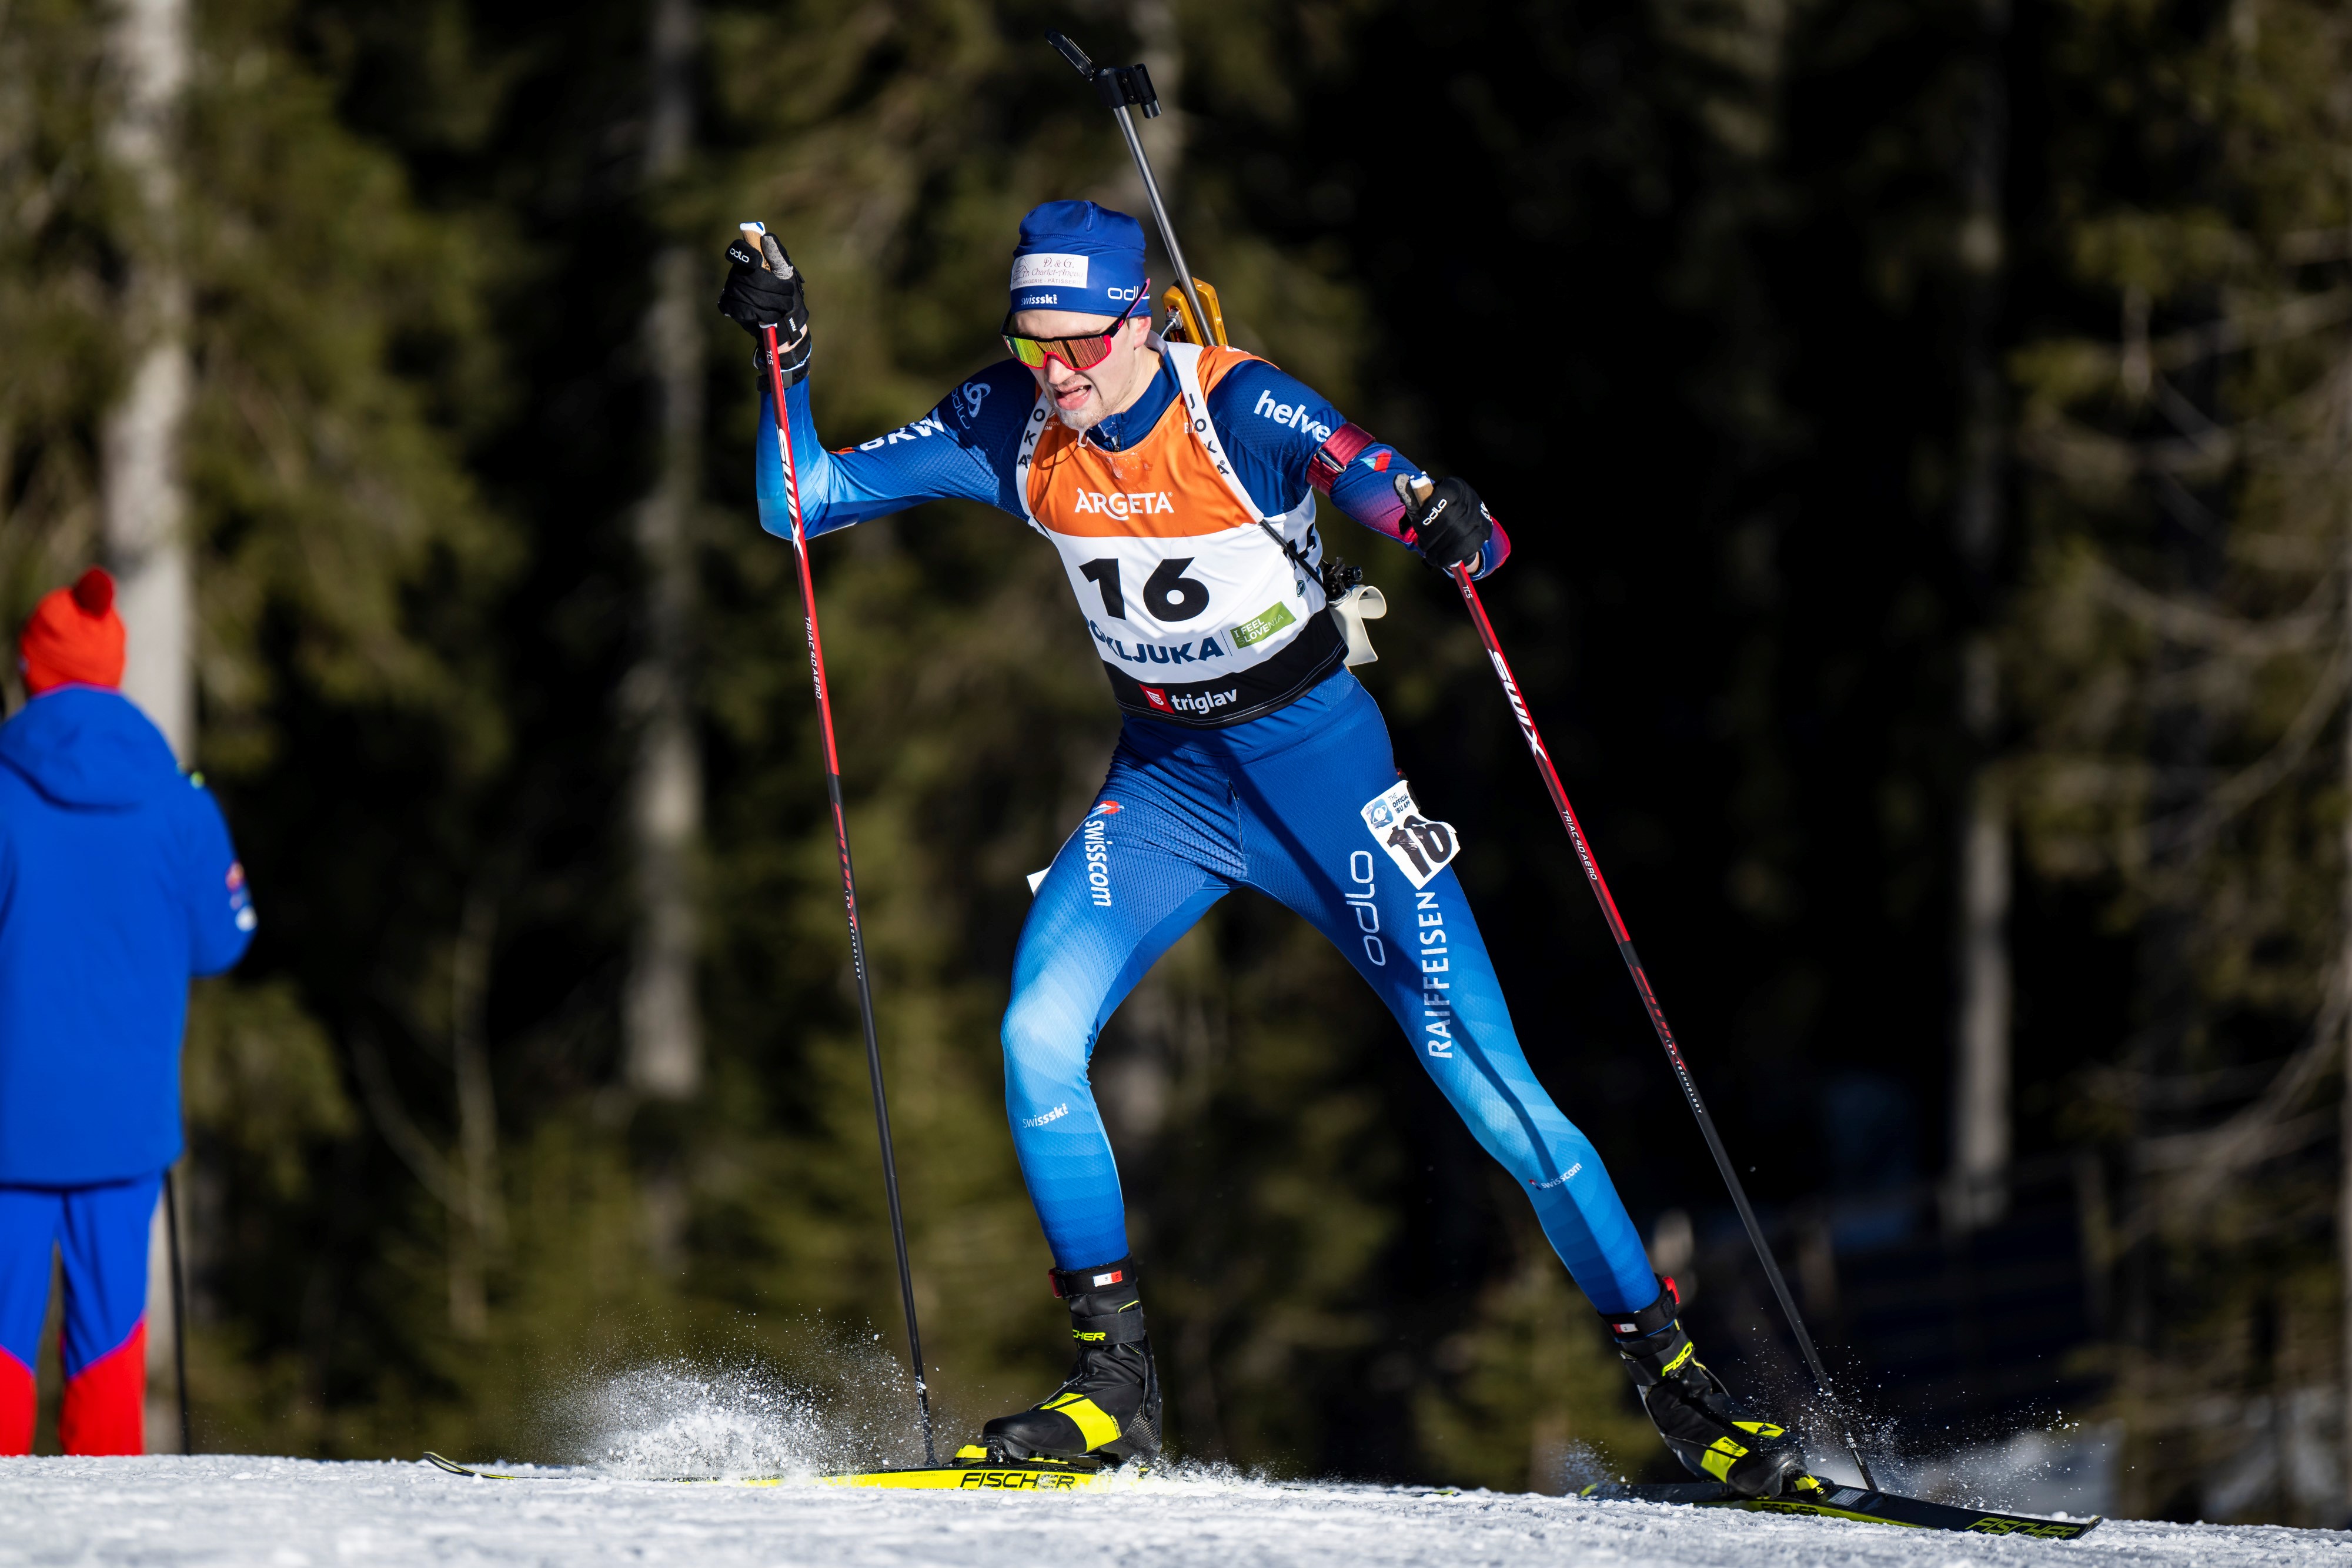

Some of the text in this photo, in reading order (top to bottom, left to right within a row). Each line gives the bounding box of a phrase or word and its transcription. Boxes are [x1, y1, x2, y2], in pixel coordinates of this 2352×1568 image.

[730, 248, 749, 263] odlo
[1054, 259, 1061, 268] &
[1021, 294, 1058, 305] swissski
[789, 317, 797, 332] WARM
[1254, 389, 1332, 443] helve
[1422, 499, 1447, 526] odlo
[1078, 556, 1210, 622] 16
[1462, 585, 1473, 599] TCS
[1238, 614, 1284, 646] SLOVENIA
[1241, 617, 1264, 635] FEEL
[805, 617, 815, 649] TRIAC
[812, 667, 821, 699] AERO
[1171, 688, 1237, 714] triglav
[1388, 793, 1398, 802] THE
[1392, 793, 1409, 808] OFFICIAL
[1562, 810, 1598, 881] TRIAC 4.0 AERO
[1084, 820, 1112, 907] swisscom
[1345, 850, 1386, 966] odlo
[1415, 892, 1452, 1058] RAIFFEISEN
[1023, 1103, 1068, 1128] swissski
[1541, 1162, 1582, 1188] swisscom
[1662, 1341, 1693, 1376] FISC
[960, 1472, 1075, 1490] FISCHER
[1965, 1517, 2080, 1539] FISCHER
